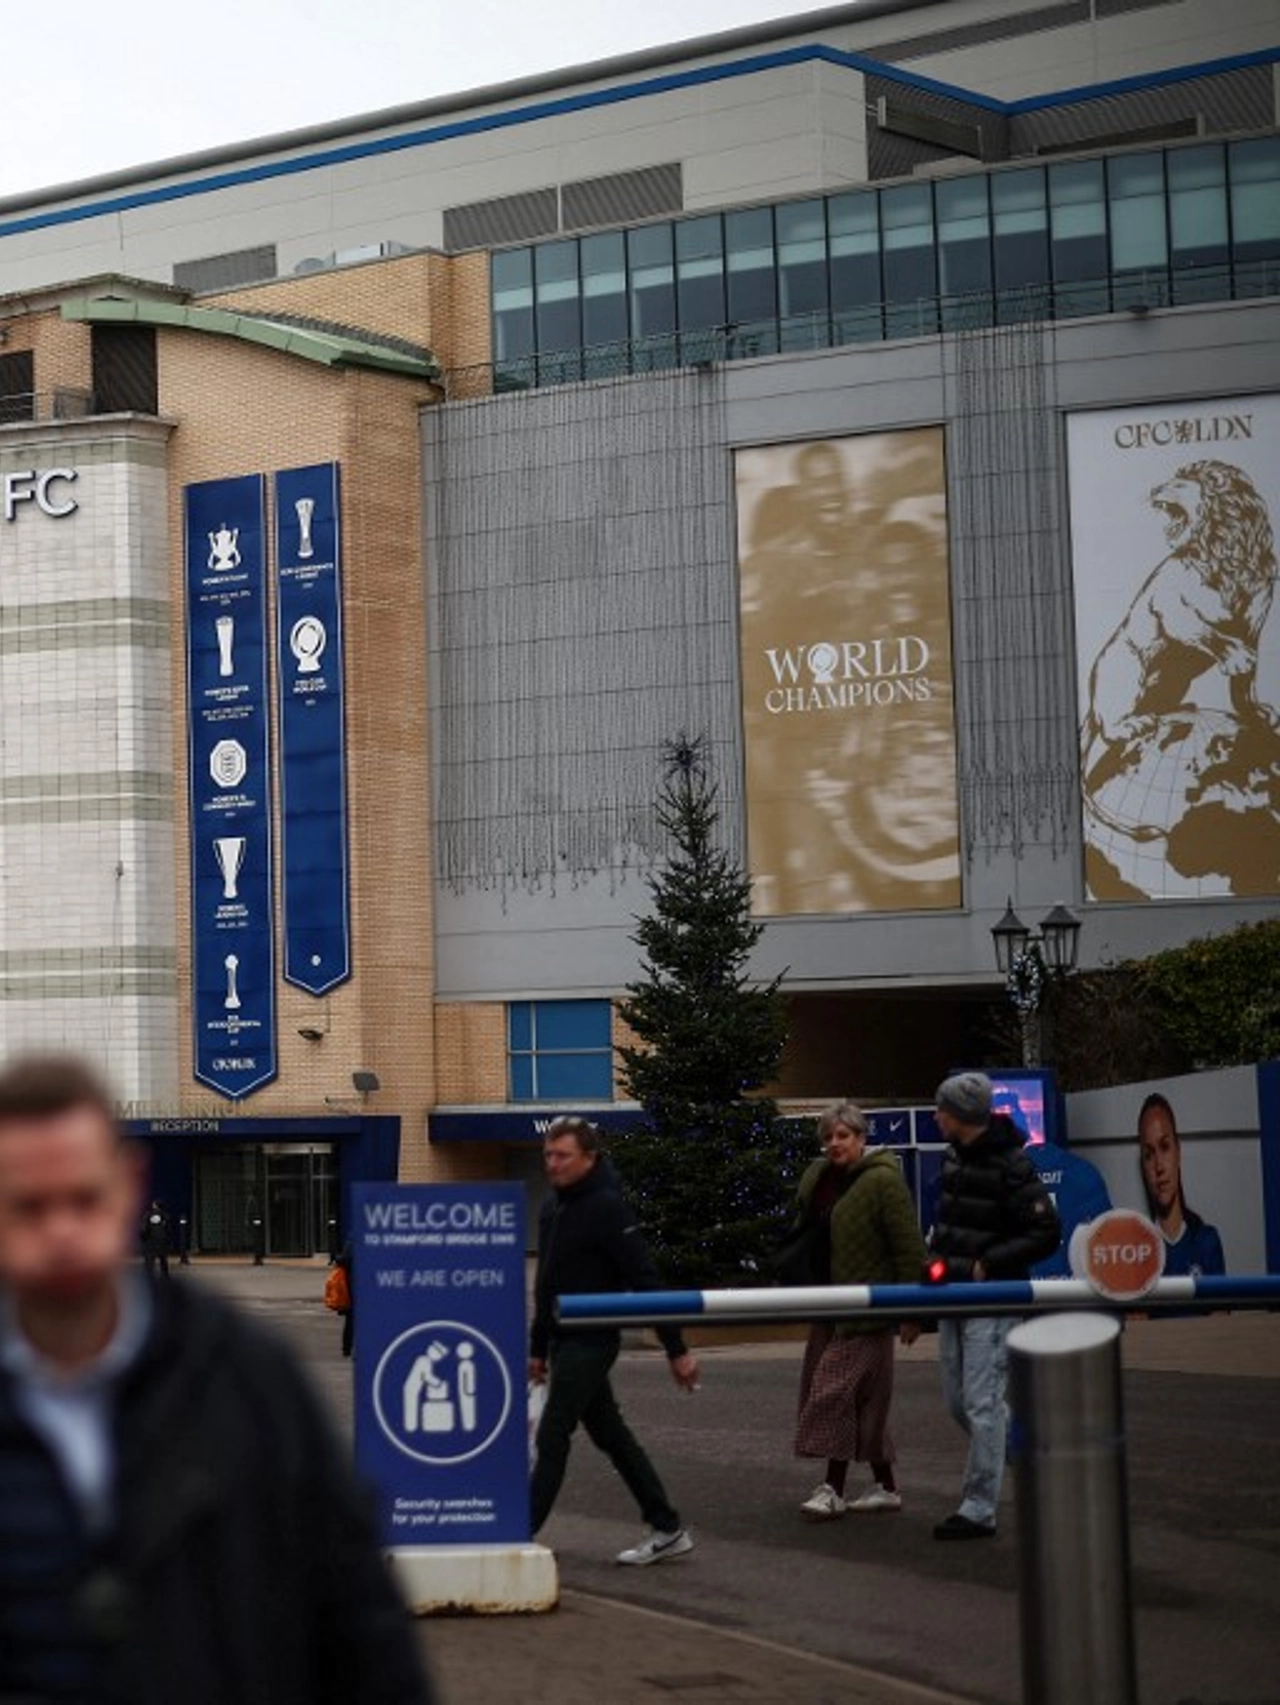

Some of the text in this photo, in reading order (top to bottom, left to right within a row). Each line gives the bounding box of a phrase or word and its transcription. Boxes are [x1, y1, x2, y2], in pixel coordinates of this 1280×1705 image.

[4, 467, 79, 523] FC
[765, 677, 932, 714] CHAMPIONS
[150, 1120, 218, 1132] RECEPTION
[364, 1202, 517, 1229] WELCOME
[365, 1234, 379, 1245] TO
[383, 1233, 443, 1246] STAMFORD
[445, 1233, 488, 1245] BRIDGE
[1092, 1243, 1152, 1265] STOP
[376, 1269, 505, 1287] WE ARE OPEN
[394, 1497, 493, 1511] Security searches
[392, 1512, 496, 1526] for your protection
